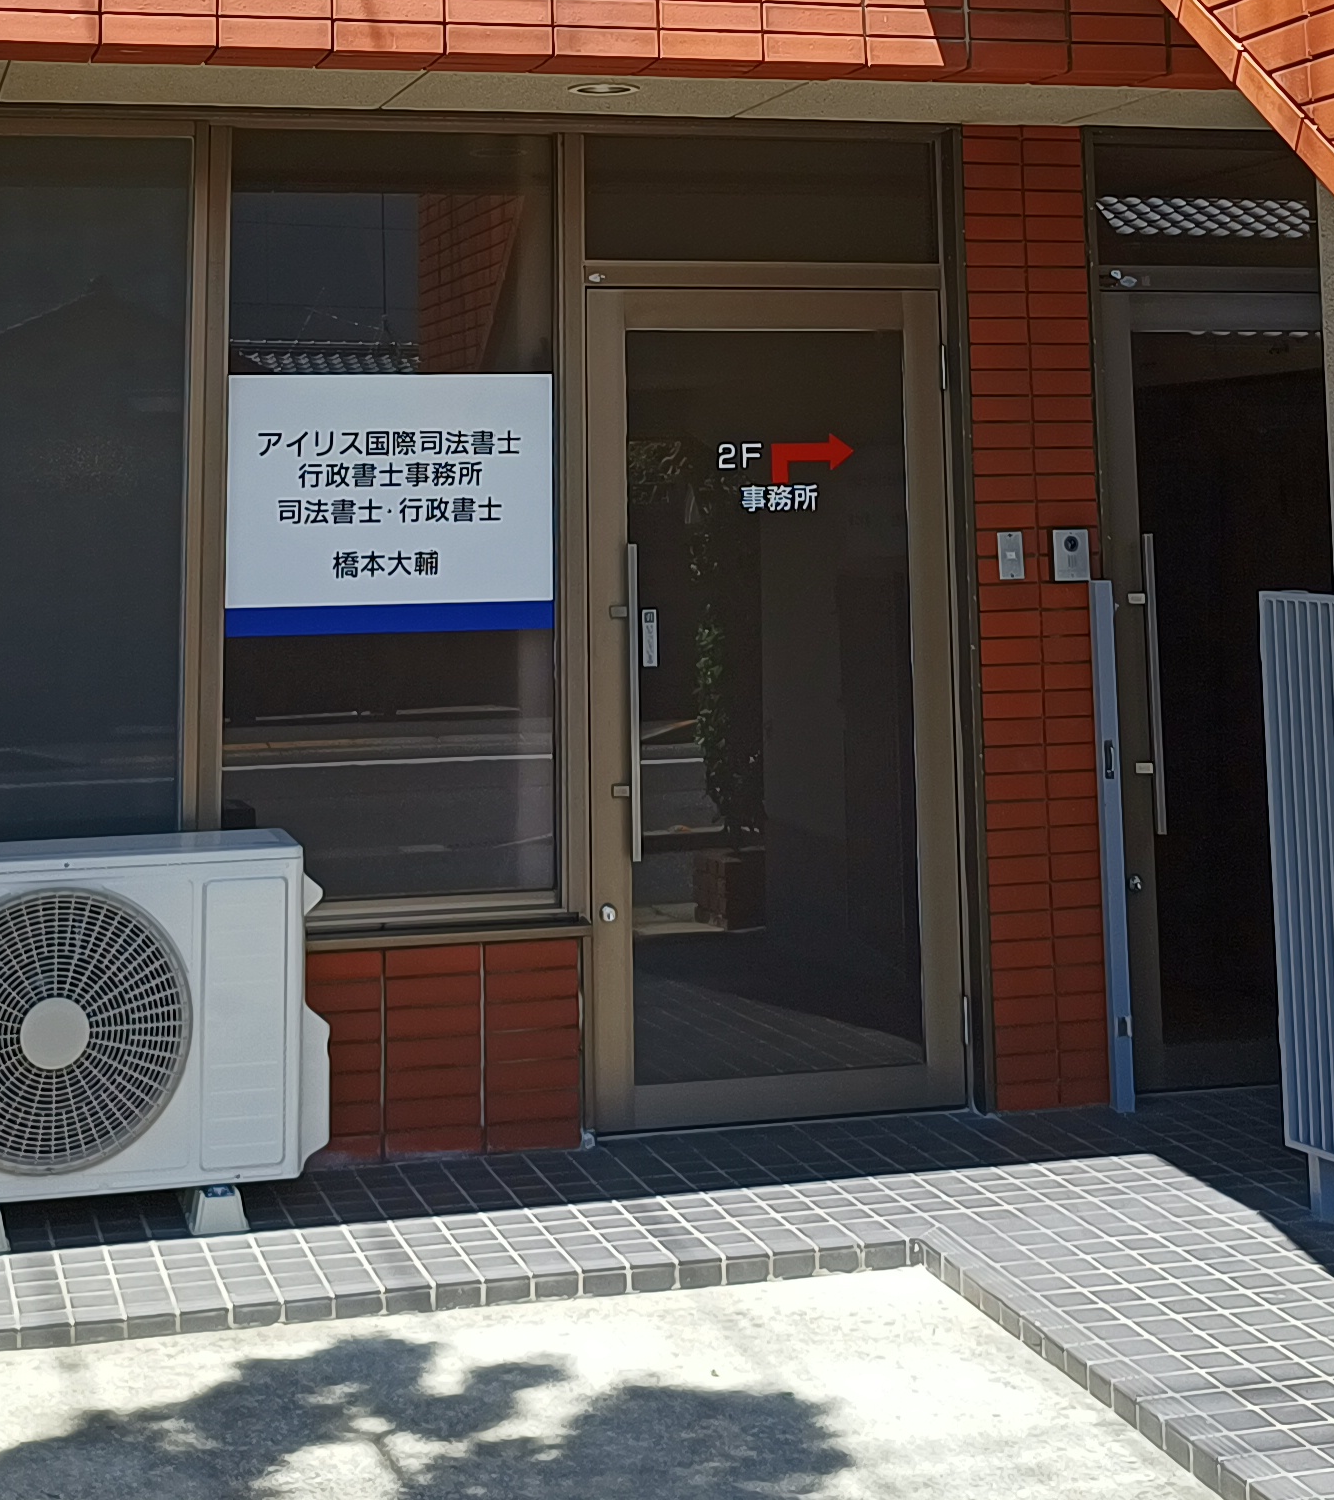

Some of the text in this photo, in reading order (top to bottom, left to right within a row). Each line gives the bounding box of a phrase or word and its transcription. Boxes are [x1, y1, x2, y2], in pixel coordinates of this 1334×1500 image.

[257, 430, 521, 457] アイリス国際司法書士
[718, 442, 762, 469] 2F
[298, 461, 483, 488] 行政書士事務所
[740, 484, 818, 512] 事務所
[332, 550, 439, 579] 橋本大輔
